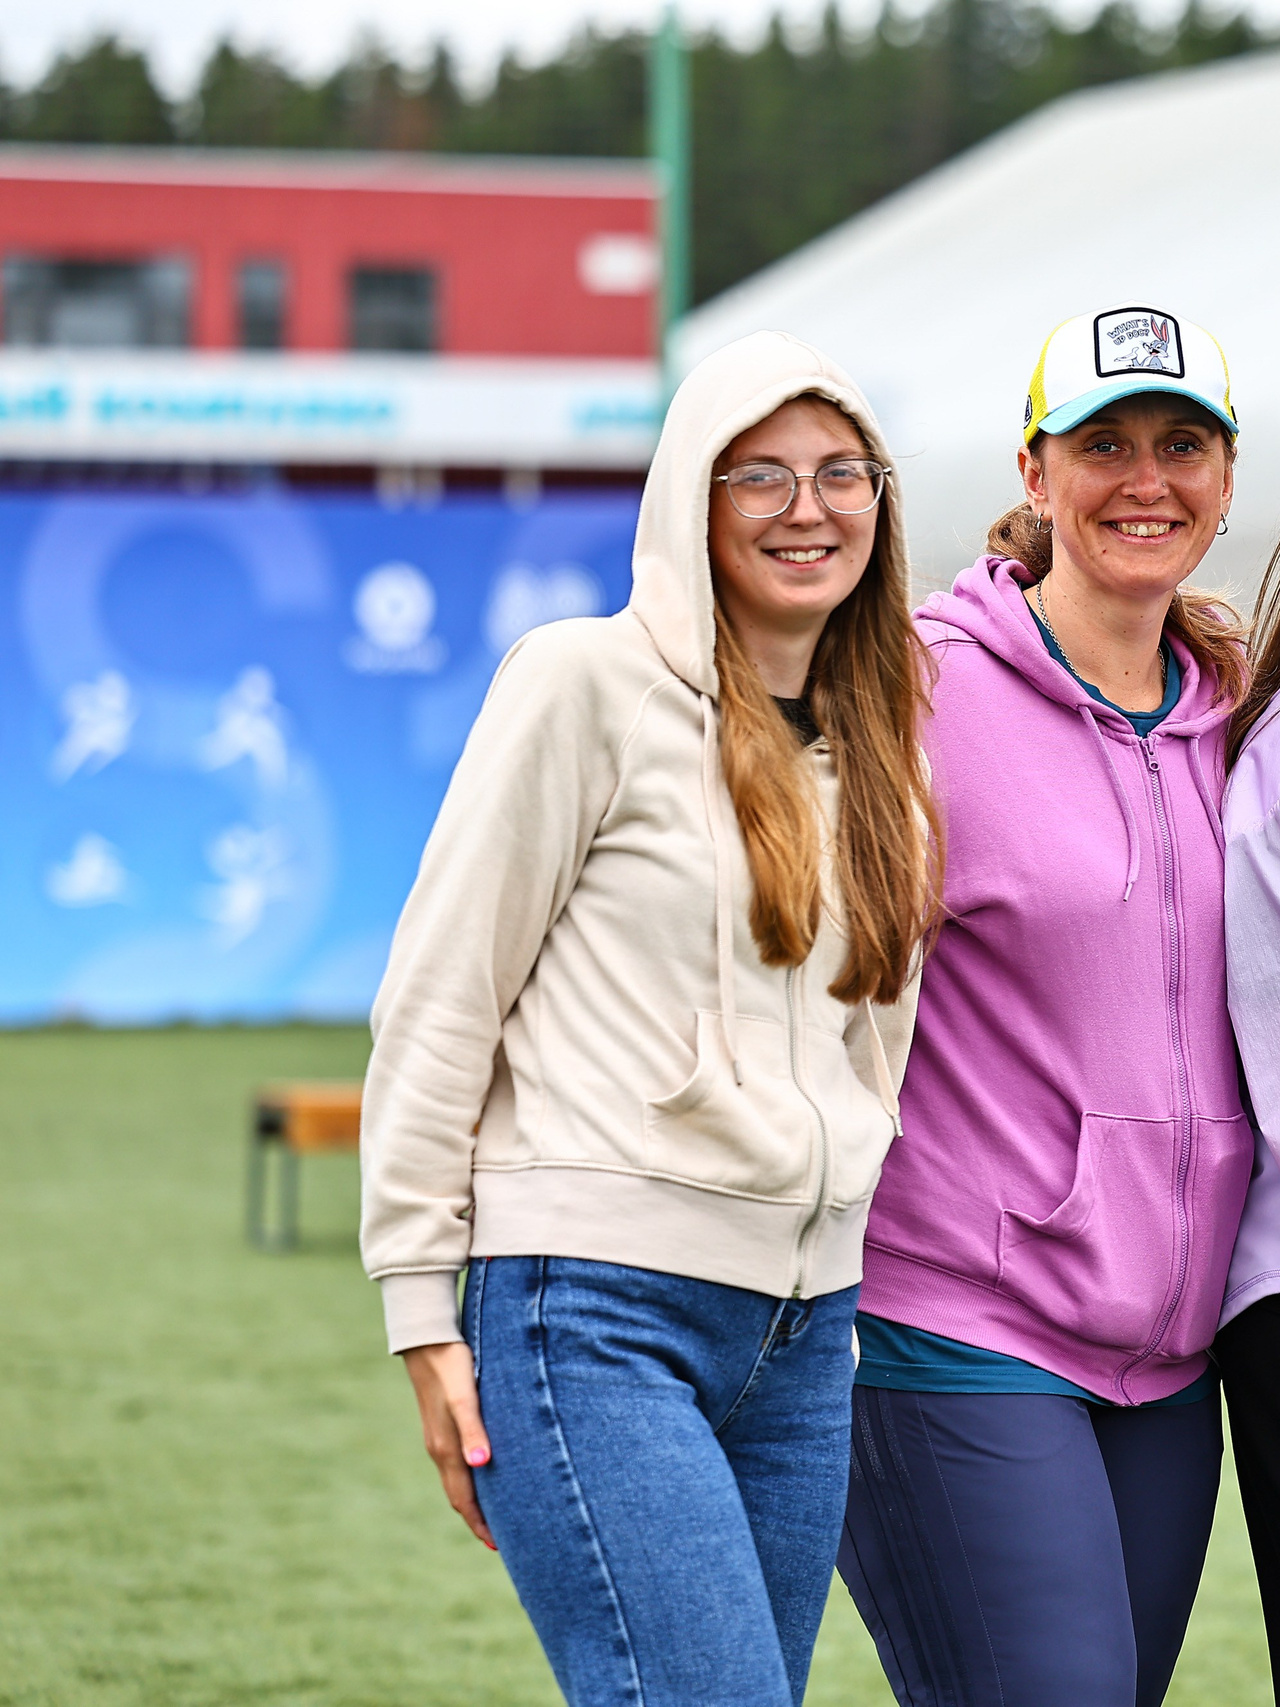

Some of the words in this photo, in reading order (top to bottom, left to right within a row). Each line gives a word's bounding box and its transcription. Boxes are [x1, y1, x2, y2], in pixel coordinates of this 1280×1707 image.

[1107, 319, 1149, 339] WHAT'S
[1113, 335, 1126, 345] UP
[1126, 329, 1150, 340] DOC?
